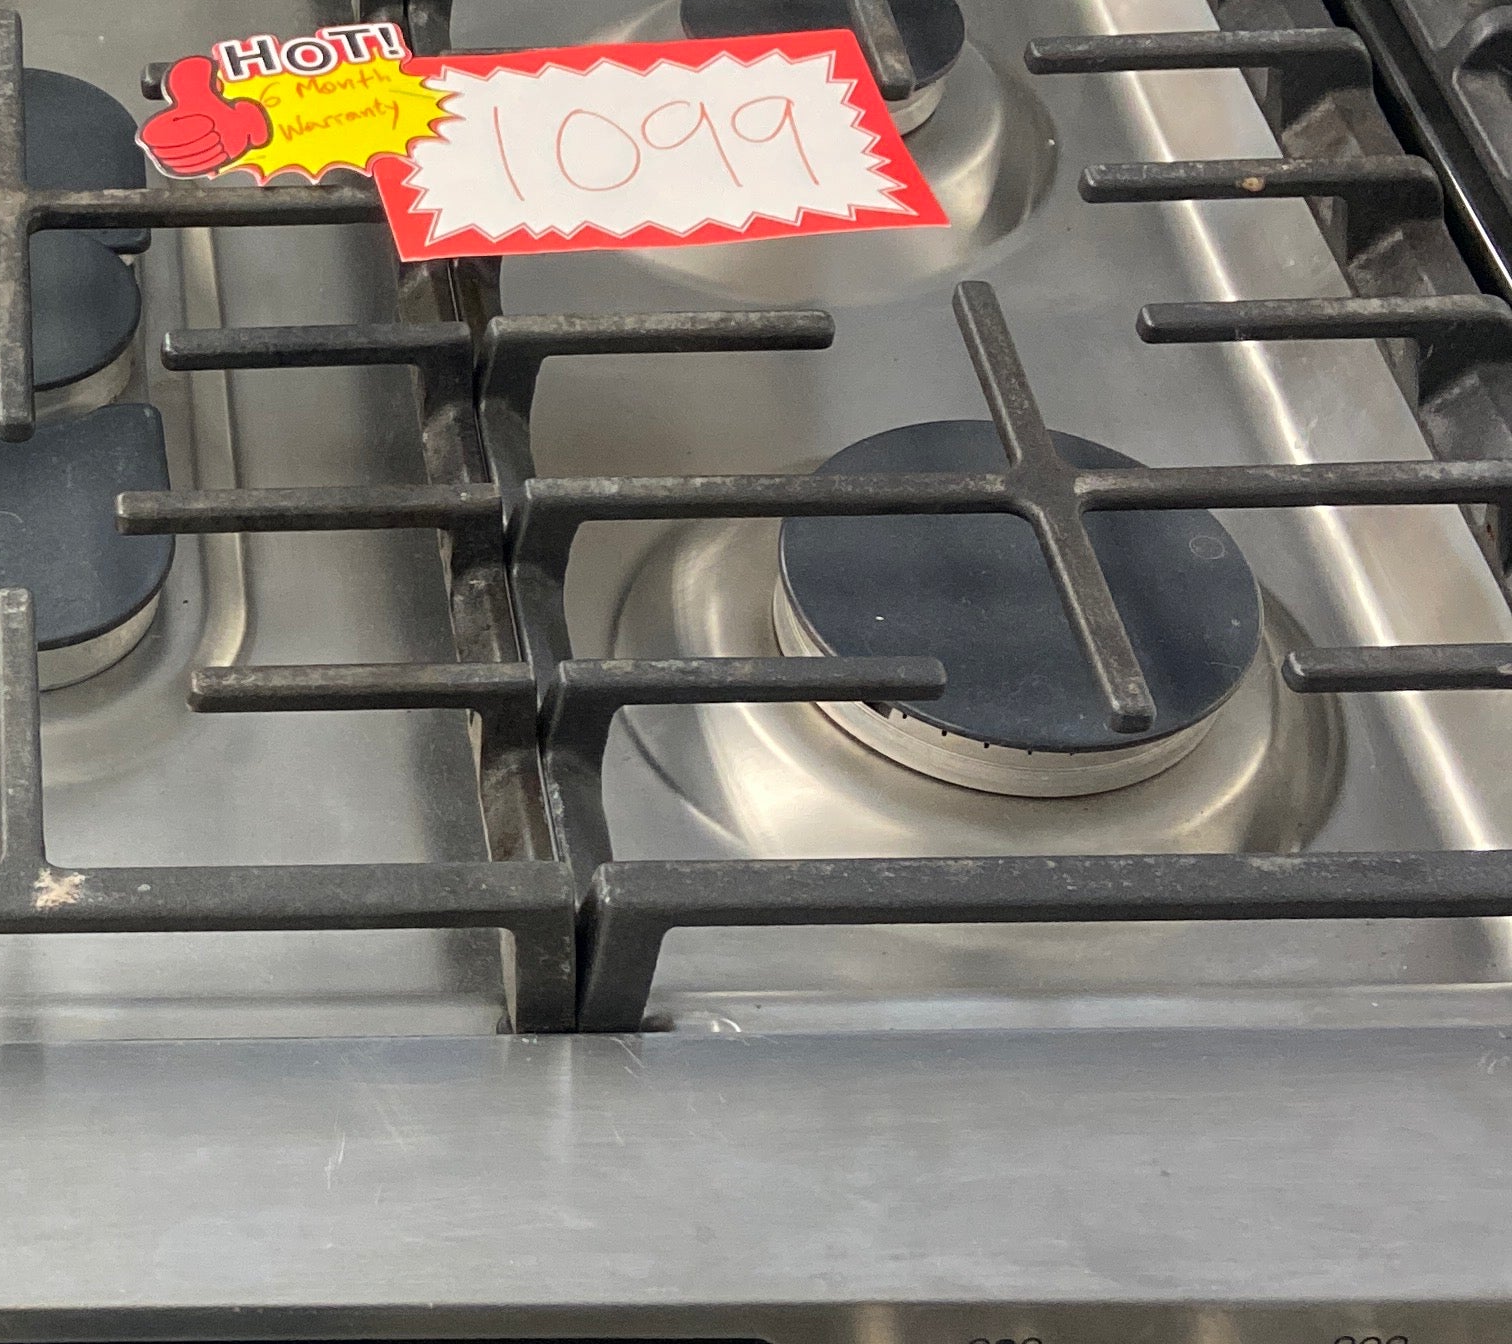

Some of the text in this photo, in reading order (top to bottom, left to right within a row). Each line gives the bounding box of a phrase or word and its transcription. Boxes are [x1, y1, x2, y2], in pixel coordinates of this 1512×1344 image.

[221, 24, 403, 79] HOT!
[259, 68, 392, 108] 6 Month
[279, 98, 400, 141] Warranty
[493, 96, 820, 201] 1099
